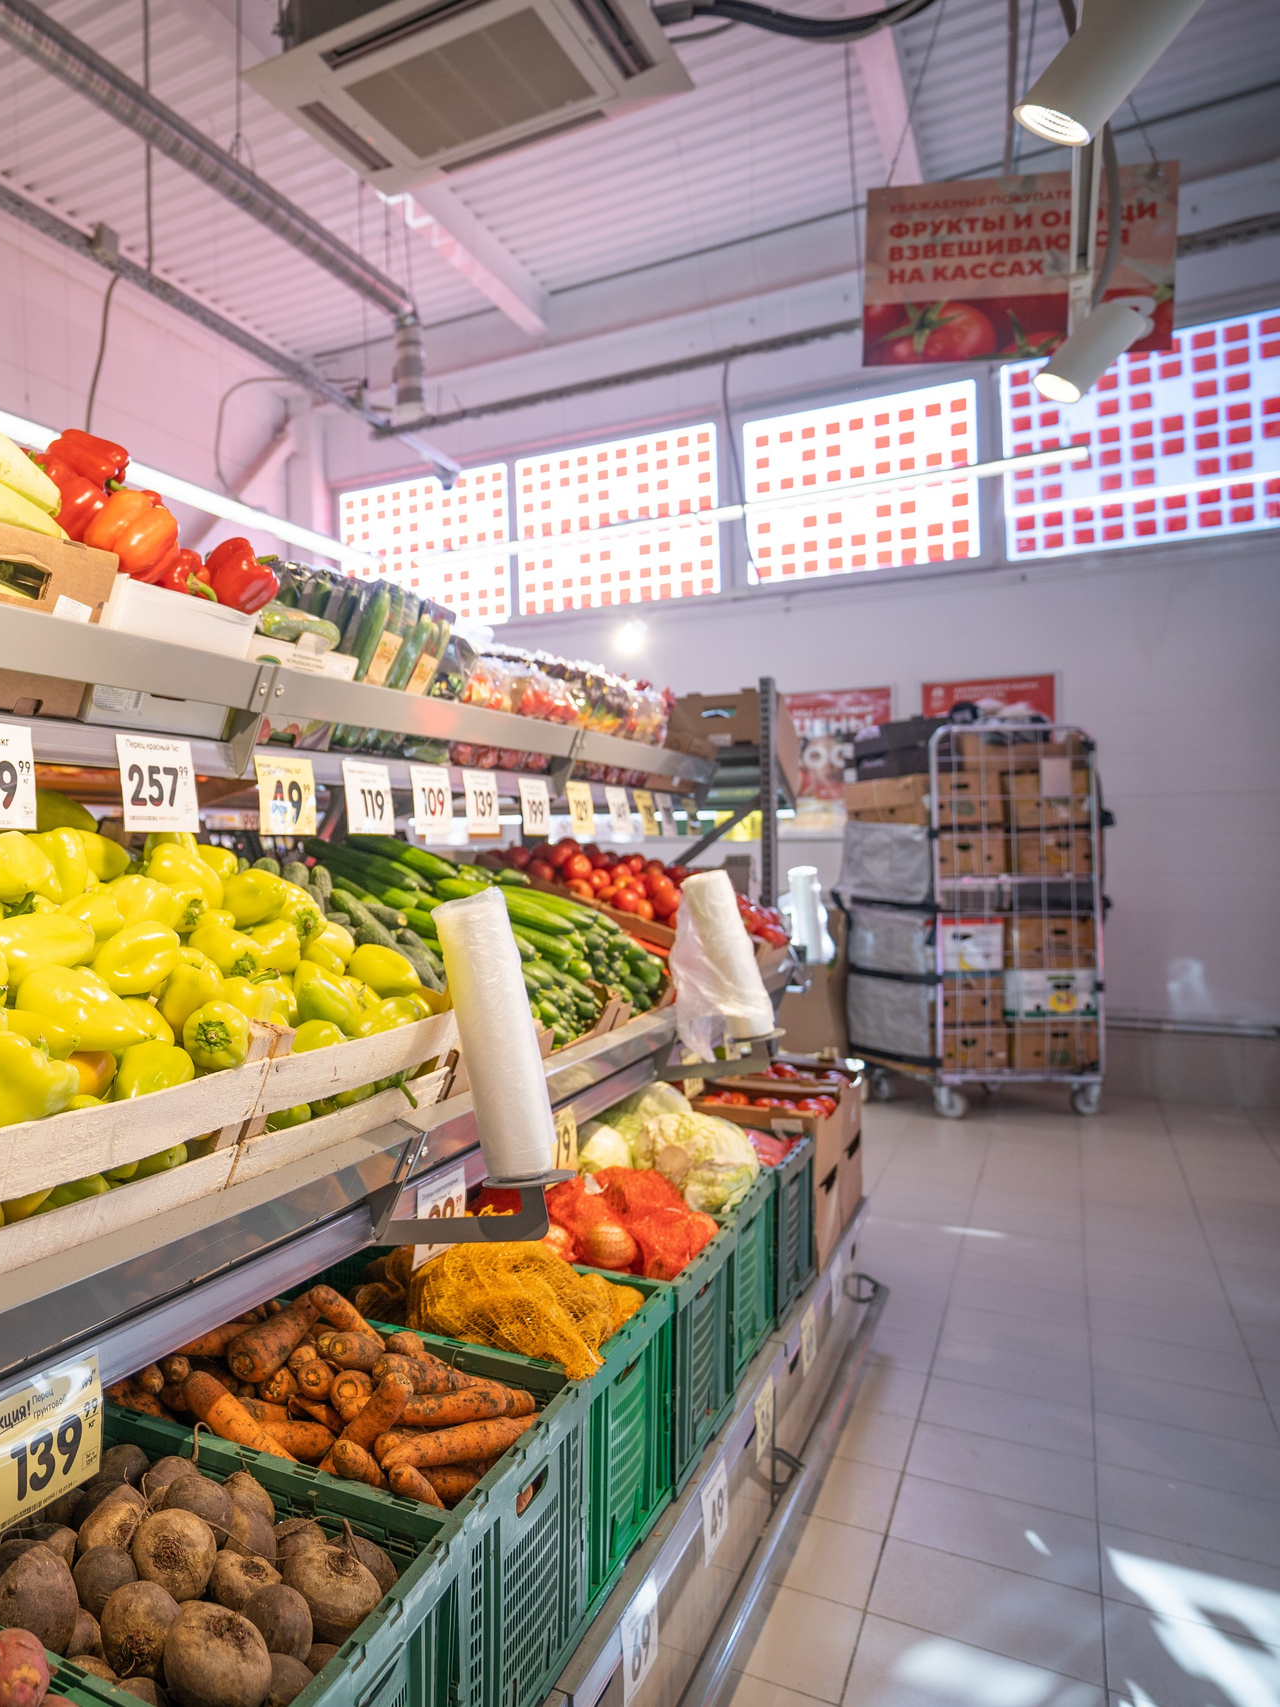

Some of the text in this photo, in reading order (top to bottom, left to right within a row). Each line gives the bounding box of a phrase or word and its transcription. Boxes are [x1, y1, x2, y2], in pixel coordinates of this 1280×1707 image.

[889, 197, 987, 214] УВАЖАЕМЫЕ
[889, 214, 1005, 239] ФРУКТЫ
[1014, 212, 1034, 230] И
[888, 259, 1044, 285] НА КАССАХ
[125, 739, 145, 750] Перец
[147, 743, 170, 752] красный
[18, 760, 31, 773] 99
[179, 766, 188, 777] 99
[128, 764, 178, 807] 257
[360, 788, 385, 821] 119
[421, 787, 445, 816] 109
[473, 790, 493, 817] 139
[527, 800, 544, 824] 199
[31, 1388, 54, 1405] Перец
[33, 1393, 67, 1420] грунтовой
[83, 1397, 98, 1418] 99
[88, 1419, 96, 1429] кг
[10, 1413, 83, 1502] 139
[710, 1487, 724, 1540] 49
[631, 1613, 651, 1682] 69
